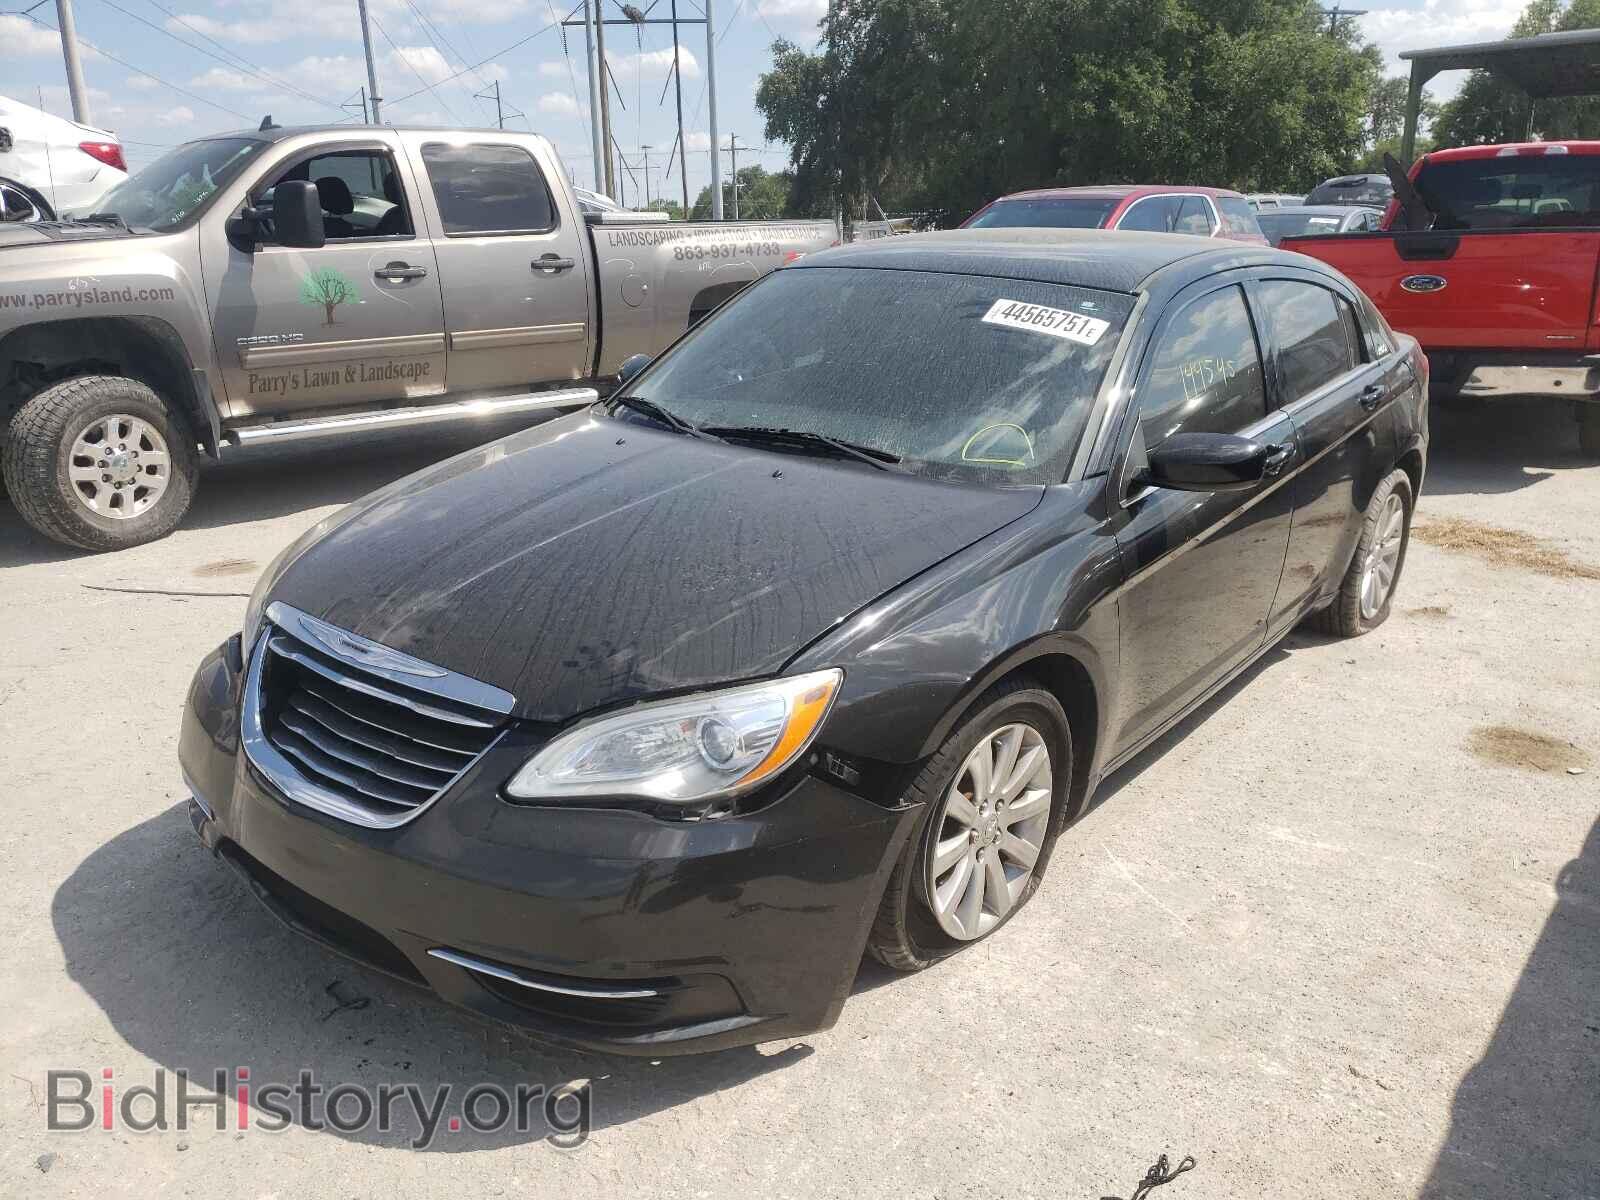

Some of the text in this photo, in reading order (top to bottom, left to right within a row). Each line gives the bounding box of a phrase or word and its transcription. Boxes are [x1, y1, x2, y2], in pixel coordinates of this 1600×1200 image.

[608, 230, 685, 248] LANDSCAPING
[672, 242, 782, 261] 863-937-4733
[1001, 302, 1091, 335] 44565751
[249, 361, 431, 395] Parry's Lawn & Landscape
